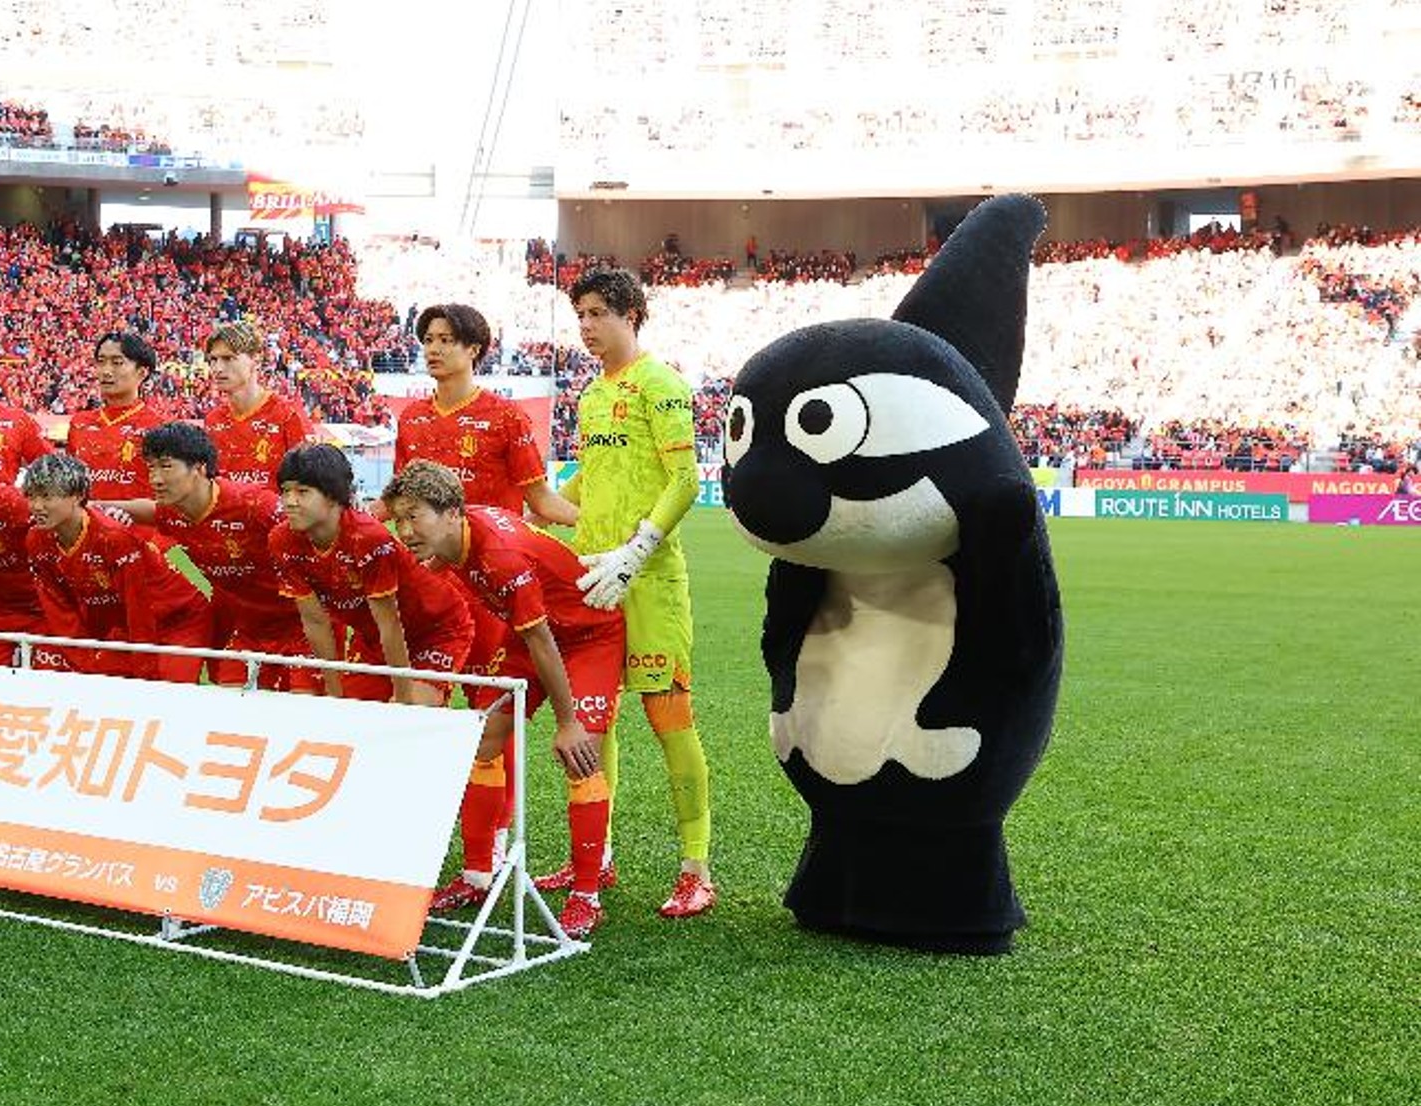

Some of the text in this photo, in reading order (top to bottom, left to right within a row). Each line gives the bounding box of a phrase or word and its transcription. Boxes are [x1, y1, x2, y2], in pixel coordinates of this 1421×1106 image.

[1080, 478, 1247, 493] AGOYA GRAMPUS
[1311, 480, 1391, 496] NAGOYA
[1101, 496, 1169, 516] ROUTE
[1217, 503, 1281, 520] HOTELS
[241, 883, 375, 931] アビスパ福岡
